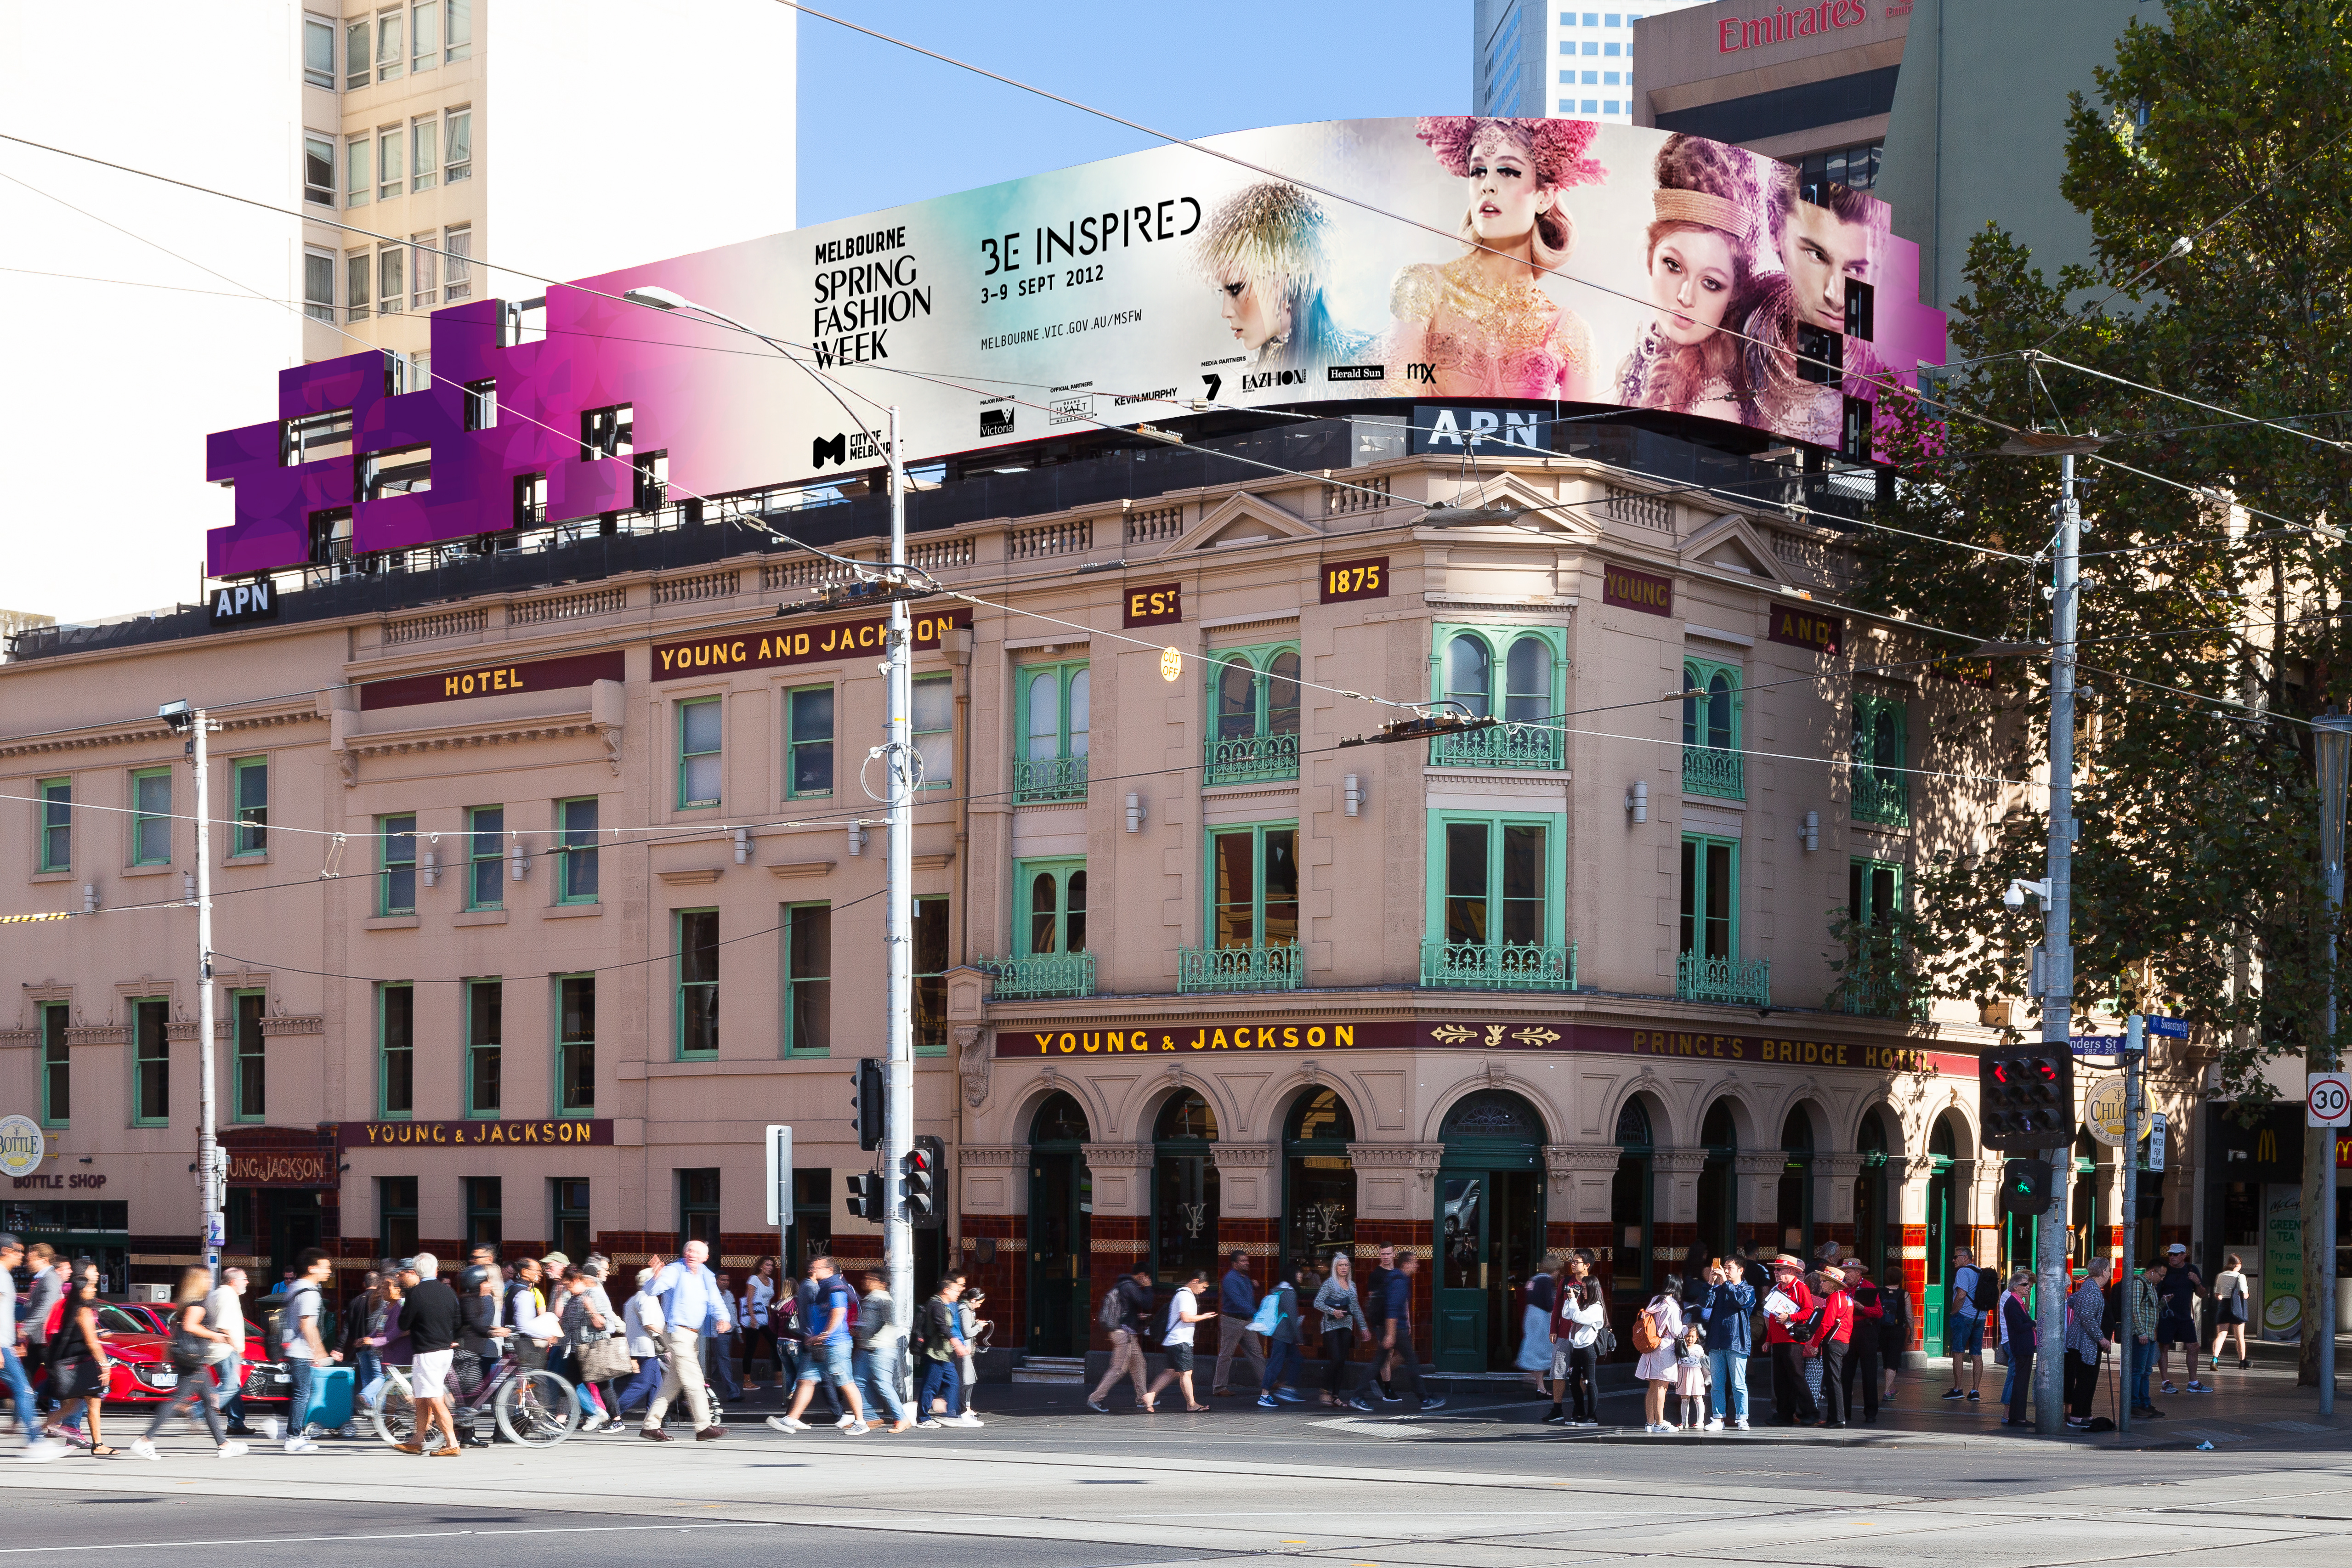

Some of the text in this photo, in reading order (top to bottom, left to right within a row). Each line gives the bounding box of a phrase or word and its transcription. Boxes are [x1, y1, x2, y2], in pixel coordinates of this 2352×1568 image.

[1717, 0, 1867, 54] Emirates
[981, 196, 1201, 276] BE INSPIRED
[815, 226, 906, 266] MELBOURNE
[814, 255, 916, 304] SPRING
[1018, 273, 1055, 297] SEPT
[1066, 264, 1104, 287] 2012
[815, 285, 931, 338] FASHION
[981, 309, 1142, 351] MELBOURNE.VIC.GOV.AU/MSFW
[812, 328, 888, 370] WEEK
[1219, 356, 1247, 364] PARTNERS
[1331, 368, 1381, 379] Herald Sun
[1071, 381, 1093, 389] PARTNERS
[1115, 387, 1178, 407] KEVIN.MURPHY
[1056, 402, 1087, 415] HYATT
[981, 424, 1013, 436] Victoria
[1428, 409, 1538, 448] APN
[850, 429, 881, 447] CITY OF
[1329, 566, 1380, 594] 1875
[216, 583, 269, 617] APN
[1607, 571, 1830, 644] YOUNG AND
[661, 616, 953, 670] YOUNG AND JACKON
[1163, 651, 1179, 664] CUT
[1163, 666, 1178, 678] OFF
[445, 668, 524, 696] HOTEL
[2161, 1018, 2188, 1032] Swanston St
[1034, 1025, 1354, 1054] YOUNG & JACKSON
[1633, 1031, 1743, 1058] PRINCE'S
[1763, 1040, 1848, 1065] BRIDGE
[2070, 1037, 2117, 1049] nders St
[2095, 1084, 2110, 1098] YOUNG
[2314, 1089, 2344, 1110] 30
[0, 1121, 10, 1132] OUNG
[367, 1123, 591, 1143] YOUNG & JACKSON
[2093, 1123, 2104, 1136] BAR
[0, 1135, 39, 1155] BOTTLE
[2153, 1138, 2163, 1146] WATCH
[262, 1156, 324, 1181] JACKSON
[2152, 1157, 2162, 1166] TRAMS
[13, 1174, 107, 1189] BOTTLE SHOP
[2270, 1197, 2301, 1212] McCaf
[2269, 1219, 2301, 1230] GREEN
[2276, 1231, 2295, 1242] TEA
[2270, 1250, 2301, 1262] Try one
[2276, 1265, 2294, 1275] here
[2273, 1280, 2296, 1292] today
